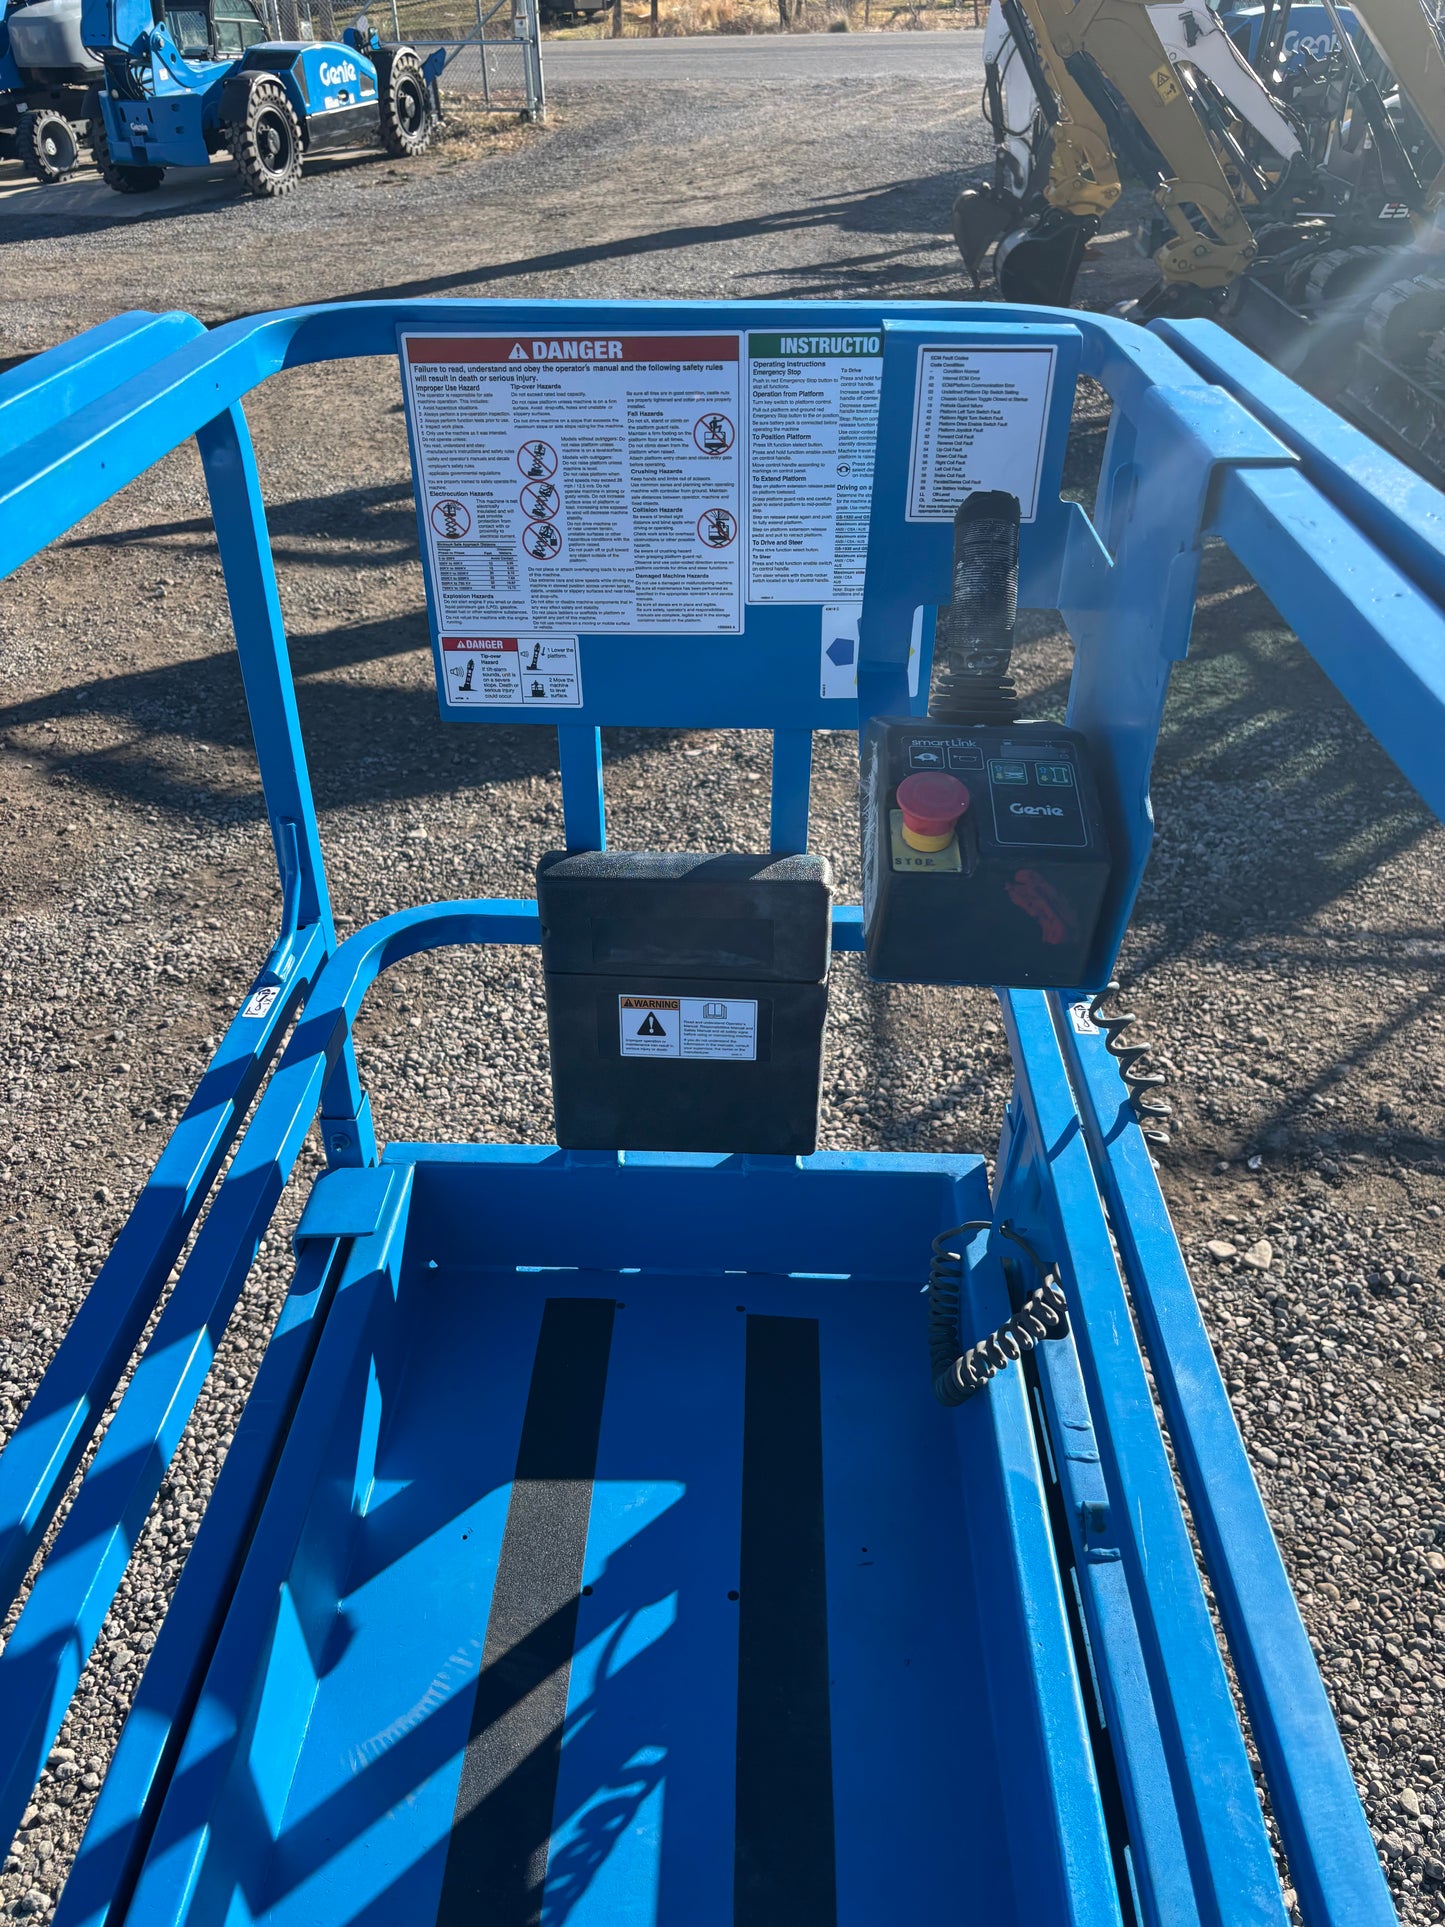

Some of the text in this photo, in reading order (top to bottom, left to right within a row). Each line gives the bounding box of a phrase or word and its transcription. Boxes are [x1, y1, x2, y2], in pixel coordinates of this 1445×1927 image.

[1282, 30, 1352, 57] Geni
[319, 60, 357, 87] Genie
[532, 341, 623, 360] DANGER
[447, 365, 466, 373] read,
[523, 365, 540, 374] obey
[554, 365, 590, 373] operator's
[647, 364, 680, 373] following
[682, 364, 703, 372] safety
[515, 375, 539, 383] injury.
[466, 640, 504, 649] DANGER
[1009, 802, 1064, 817] Genie
[895, 858, 935, 867] STOP
[634, 999, 678, 1009] WARNING
